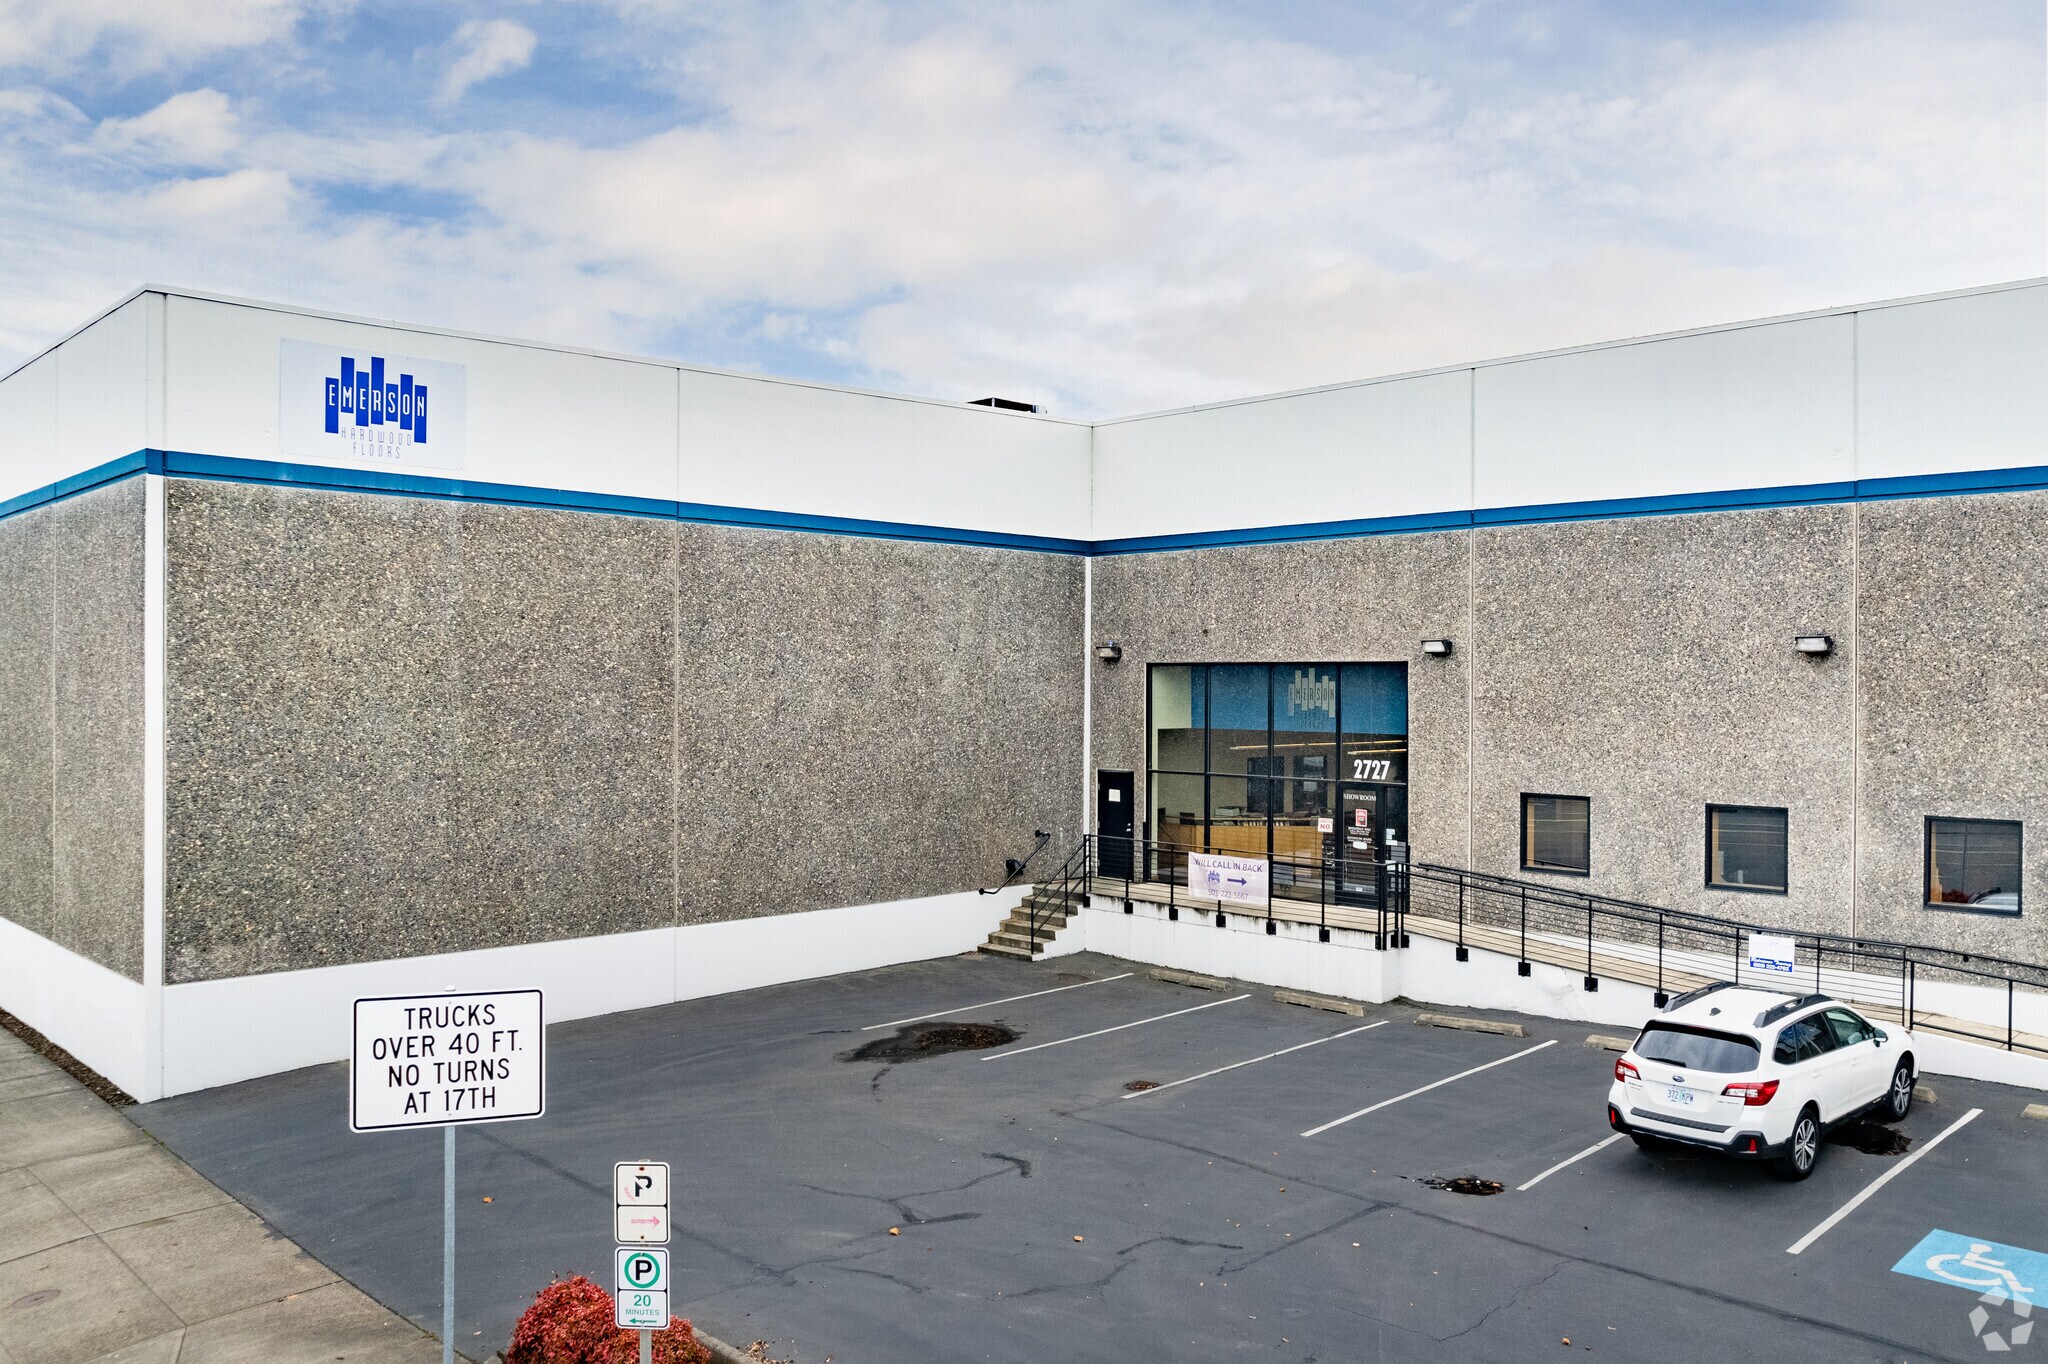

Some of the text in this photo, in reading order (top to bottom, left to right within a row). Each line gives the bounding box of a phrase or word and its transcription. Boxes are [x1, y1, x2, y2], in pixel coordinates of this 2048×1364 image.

[329, 384, 424, 416] EMERSON
[341, 427, 412, 446] HARDWOOD
[352, 442, 400, 459] FLOORS
[1290, 687, 1335, 701] EMERSON
[1354, 759, 1390, 780] 2727
[1343, 793, 1376, 801] SHOWROOM
[1195, 858, 1262, 872] WILL CALL IN BACK
[404, 1004, 496, 1030] TRUCKS
[372, 1029, 523, 1060] OVER 40 FT.
[388, 1058, 510, 1088] NO TURNS
[404, 1086, 496, 1115] AT 17TH
[635, 1260, 652, 1280] P
[633, 1294, 652, 1307] 20
[625, 1308, 660, 1316] MINUTES
